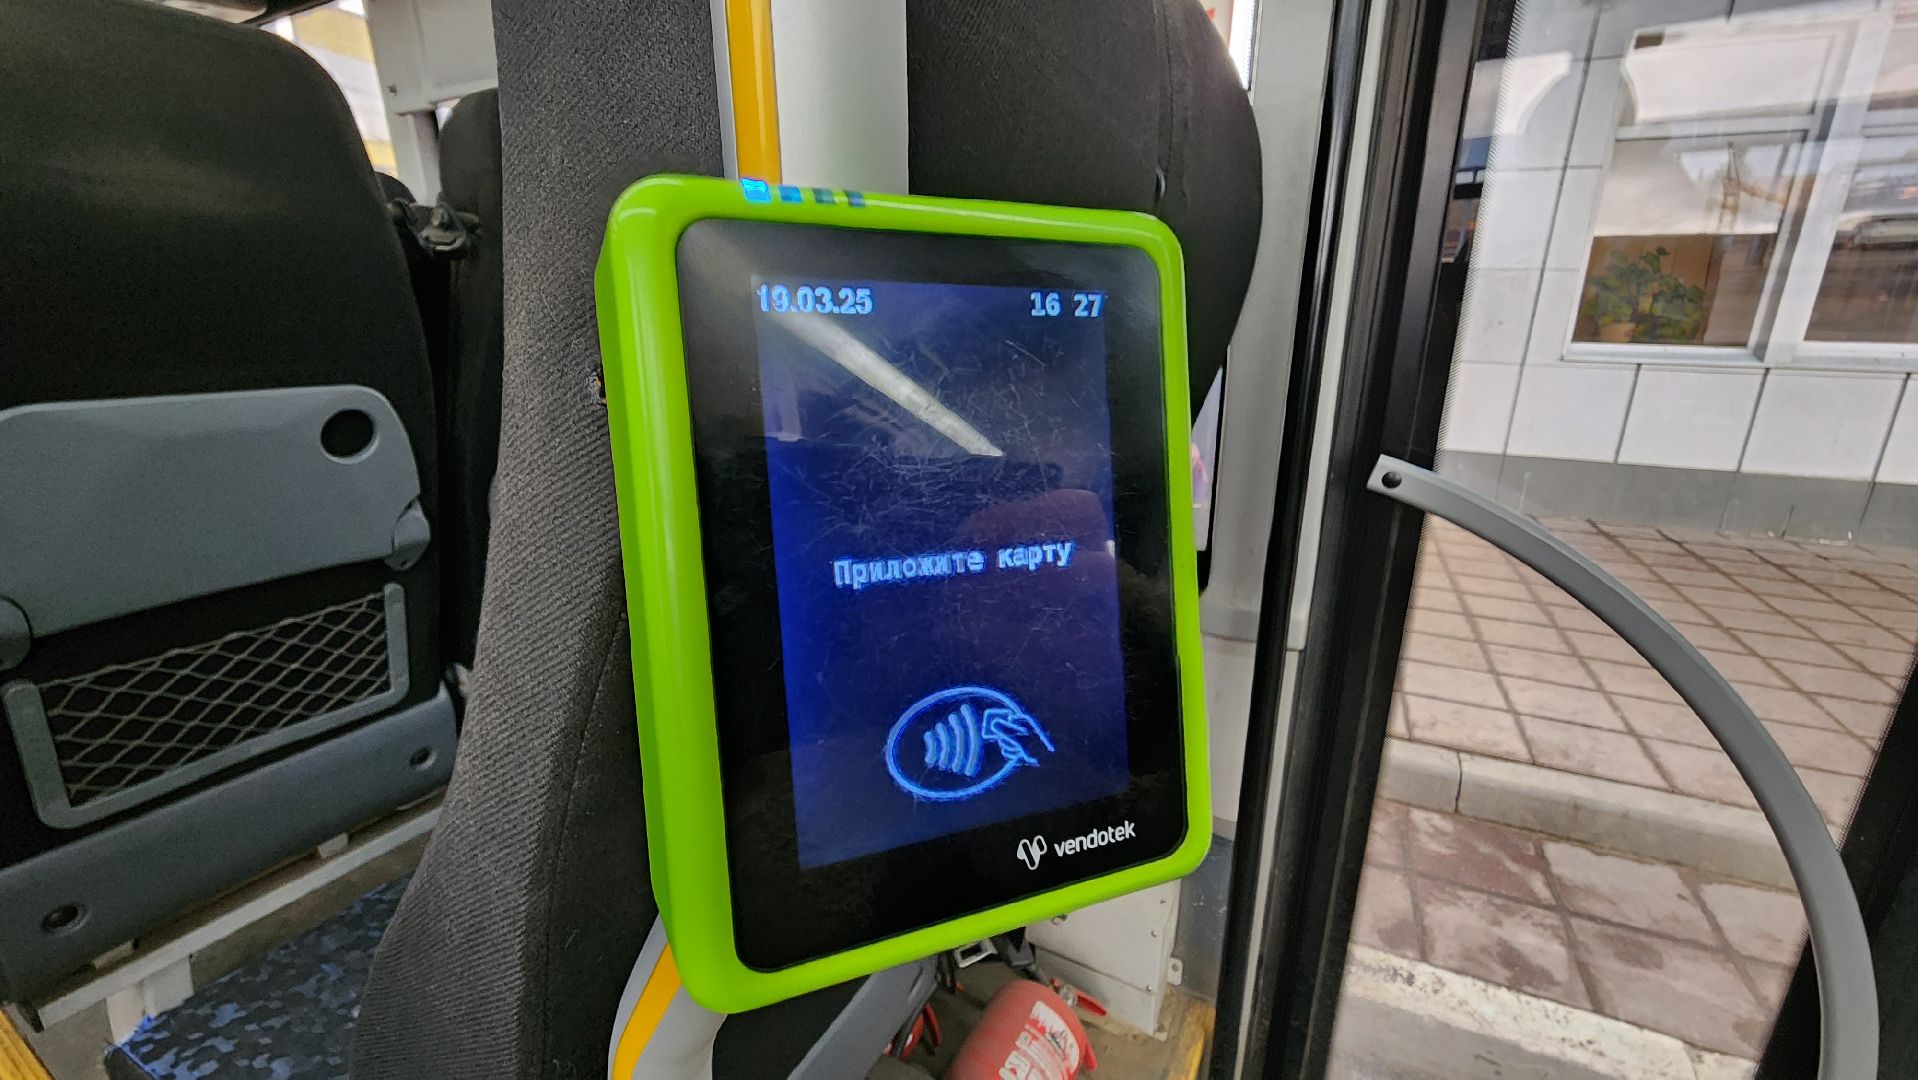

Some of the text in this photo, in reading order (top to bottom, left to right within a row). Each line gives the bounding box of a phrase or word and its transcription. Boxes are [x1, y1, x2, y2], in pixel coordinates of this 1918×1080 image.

[757, 283, 873, 315] 19.03.25
[1030, 291, 1104, 318] 16 27
[833, 540, 1074, 590] Приложите карту
[1053, 820, 1137, 857] vendotek
